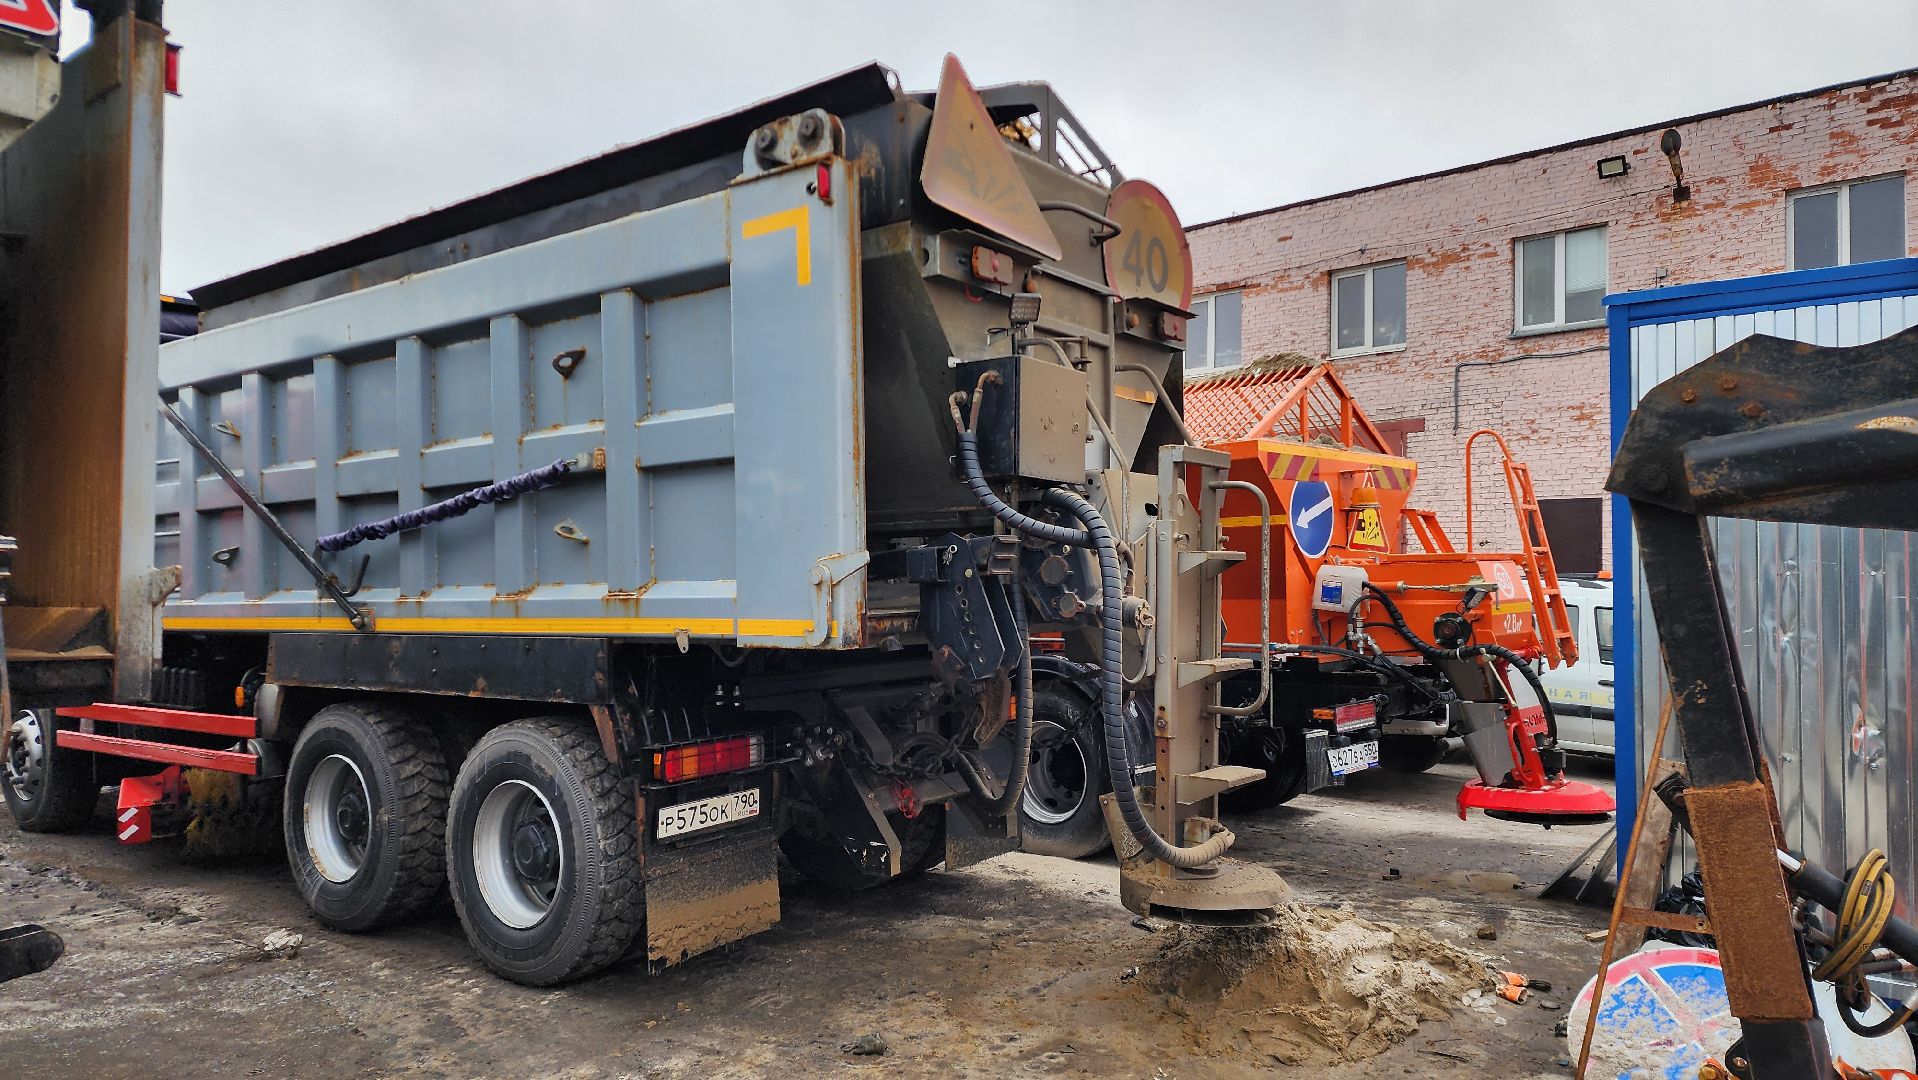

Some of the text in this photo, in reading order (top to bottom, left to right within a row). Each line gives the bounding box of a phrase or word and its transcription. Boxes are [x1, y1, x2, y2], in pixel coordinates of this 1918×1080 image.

[1123, 228, 1169, 293] 40
[665, 792, 755, 833] Р575ОК 790
